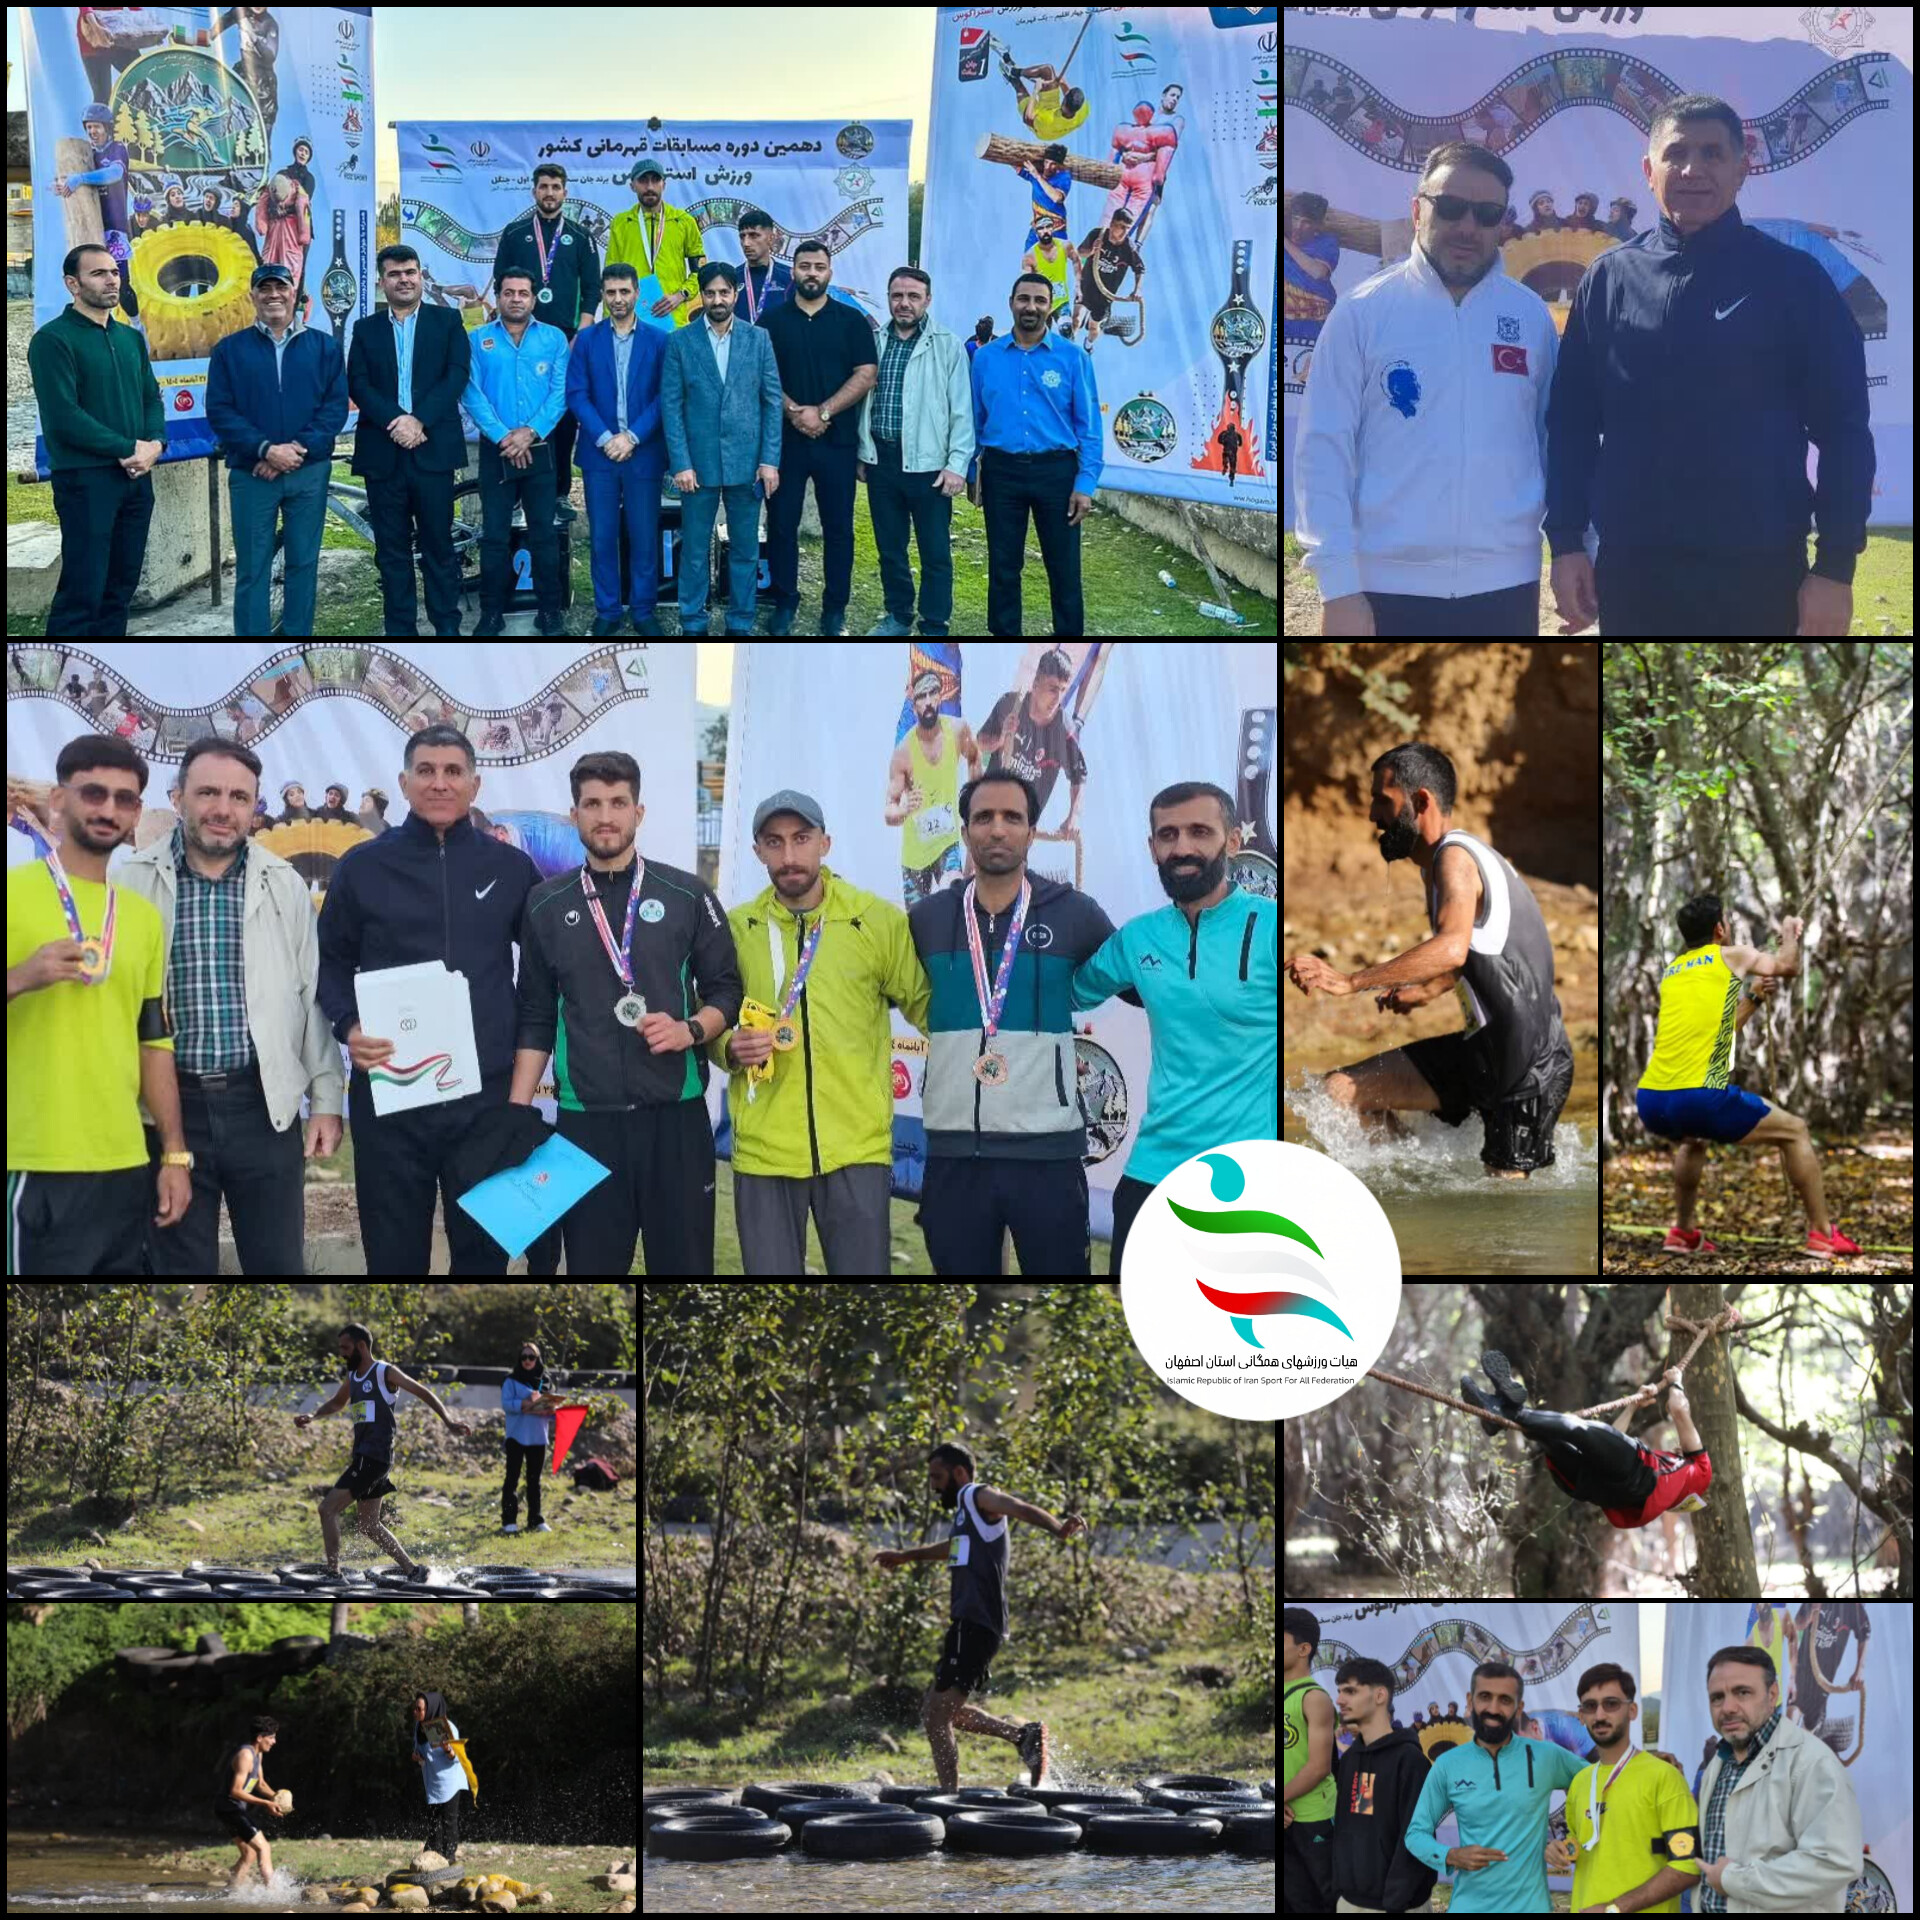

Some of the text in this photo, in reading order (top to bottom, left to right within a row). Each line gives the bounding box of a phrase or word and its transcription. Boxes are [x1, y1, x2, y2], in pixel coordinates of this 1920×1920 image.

[538, 137, 822, 158] دهمین دوره مسابقات قهرمانی کشور
[705, 165, 752, 186] ورزش
[513, 549, 534, 590] 2
